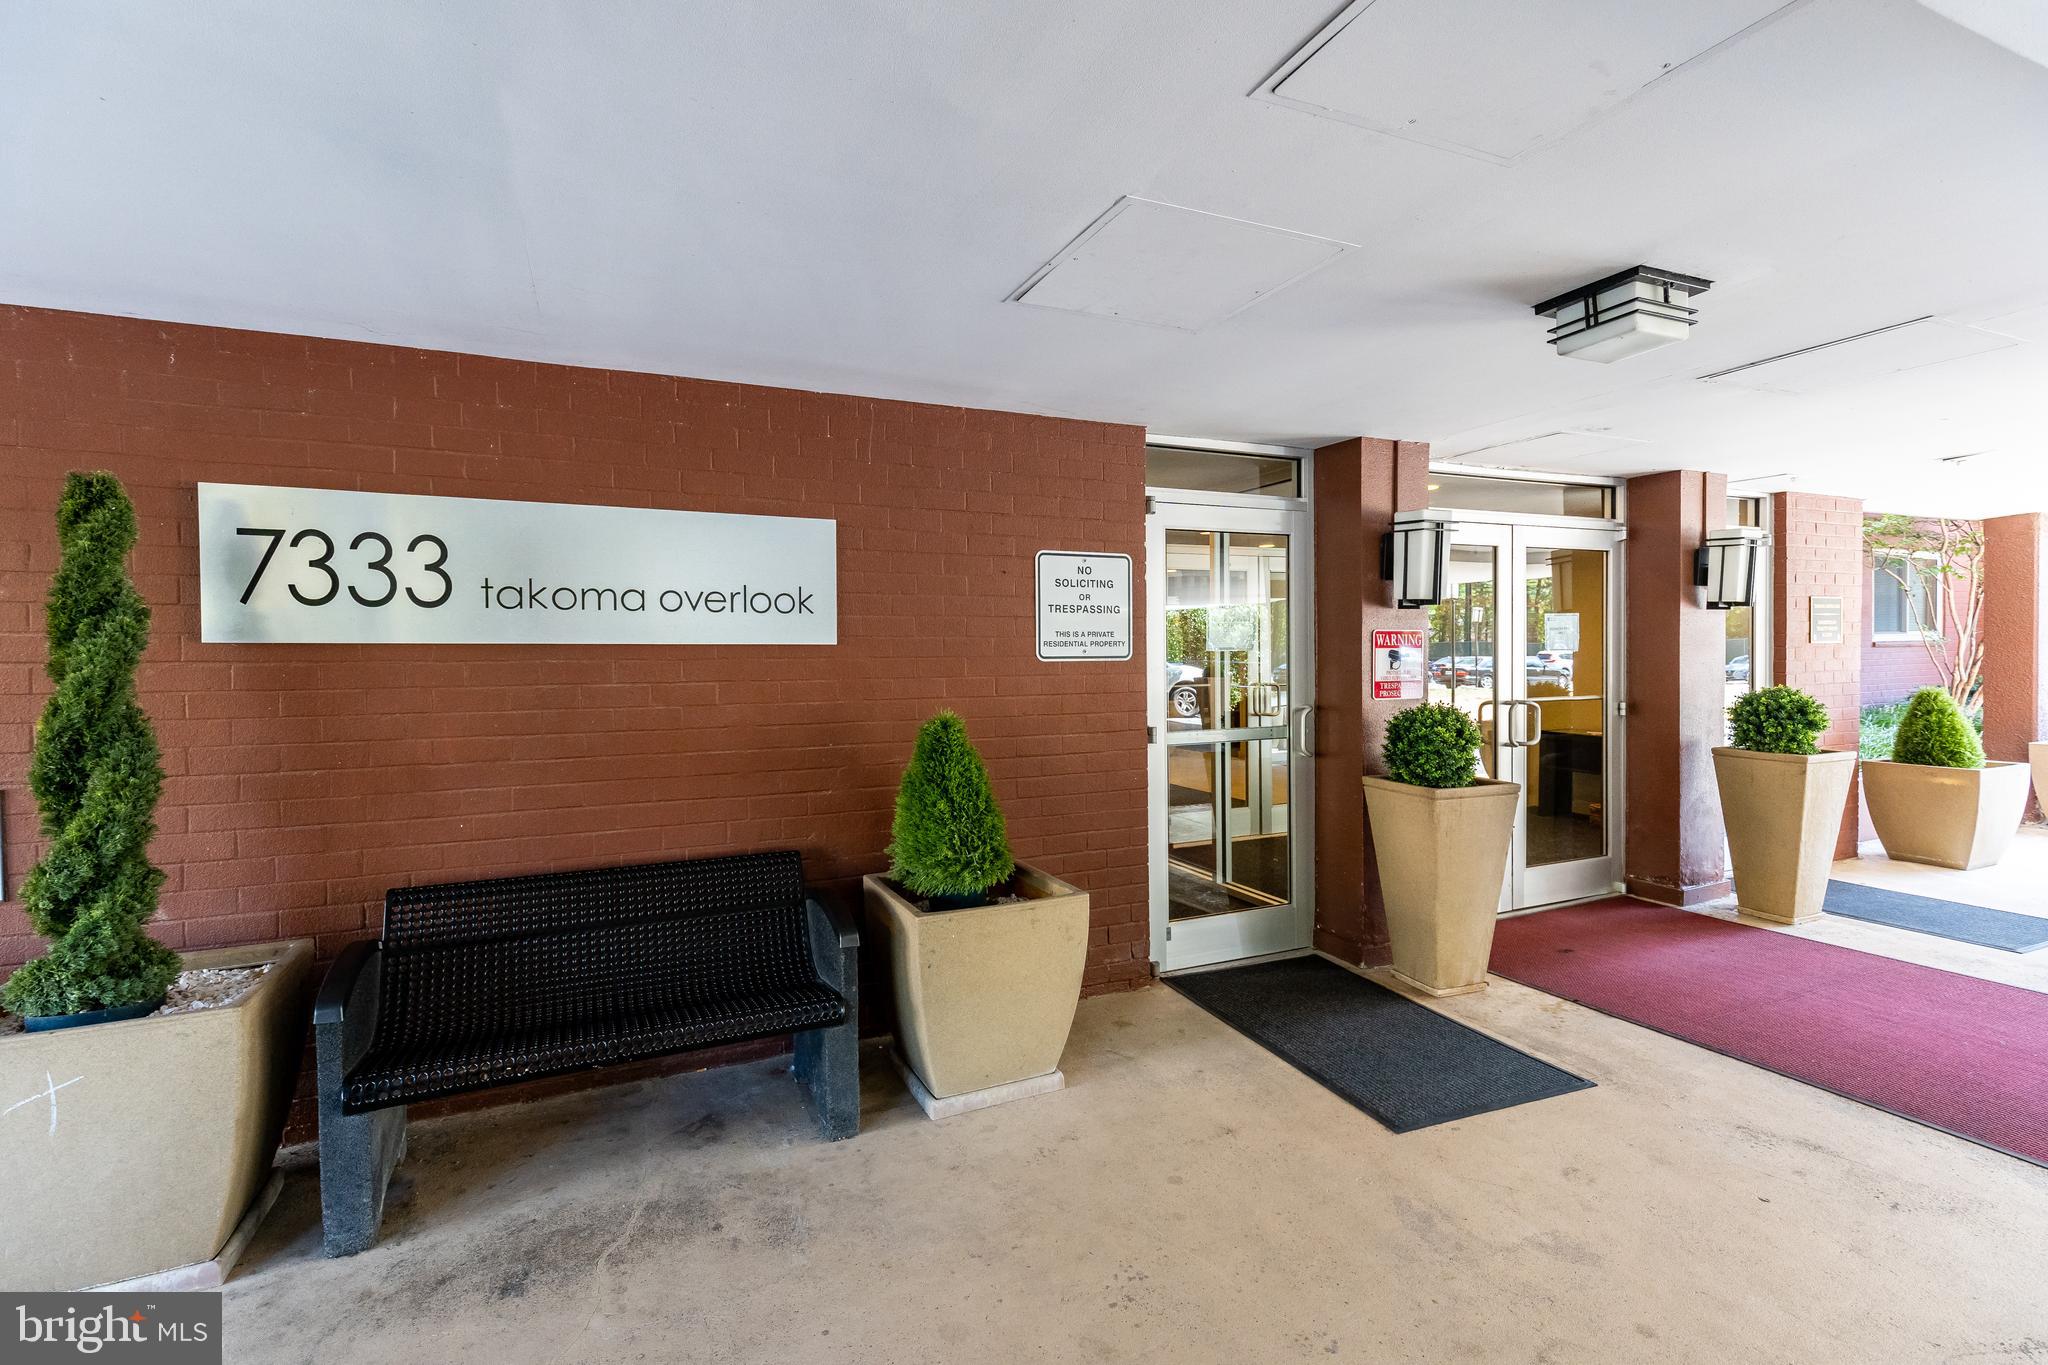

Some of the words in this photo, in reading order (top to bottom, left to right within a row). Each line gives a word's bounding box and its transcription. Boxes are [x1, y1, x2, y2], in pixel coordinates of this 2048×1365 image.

[236, 528, 453, 609] 7333
[481, 577, 645, 612] takoma
[659, 585, 814, 615] overlook
[1077, 566, 1092, 575] NO
[1054, 578, 1114, 589] SOLICITING
[1078, 593, 1091, 601] OR
[1048, 604, 1121, 614] TRESPASSING
[1055, 630, 1071, 638] THIS
[1043, 640, 1088, 648] RESIDENTIAL
[1376, 633, 1422, 647] WARNING
